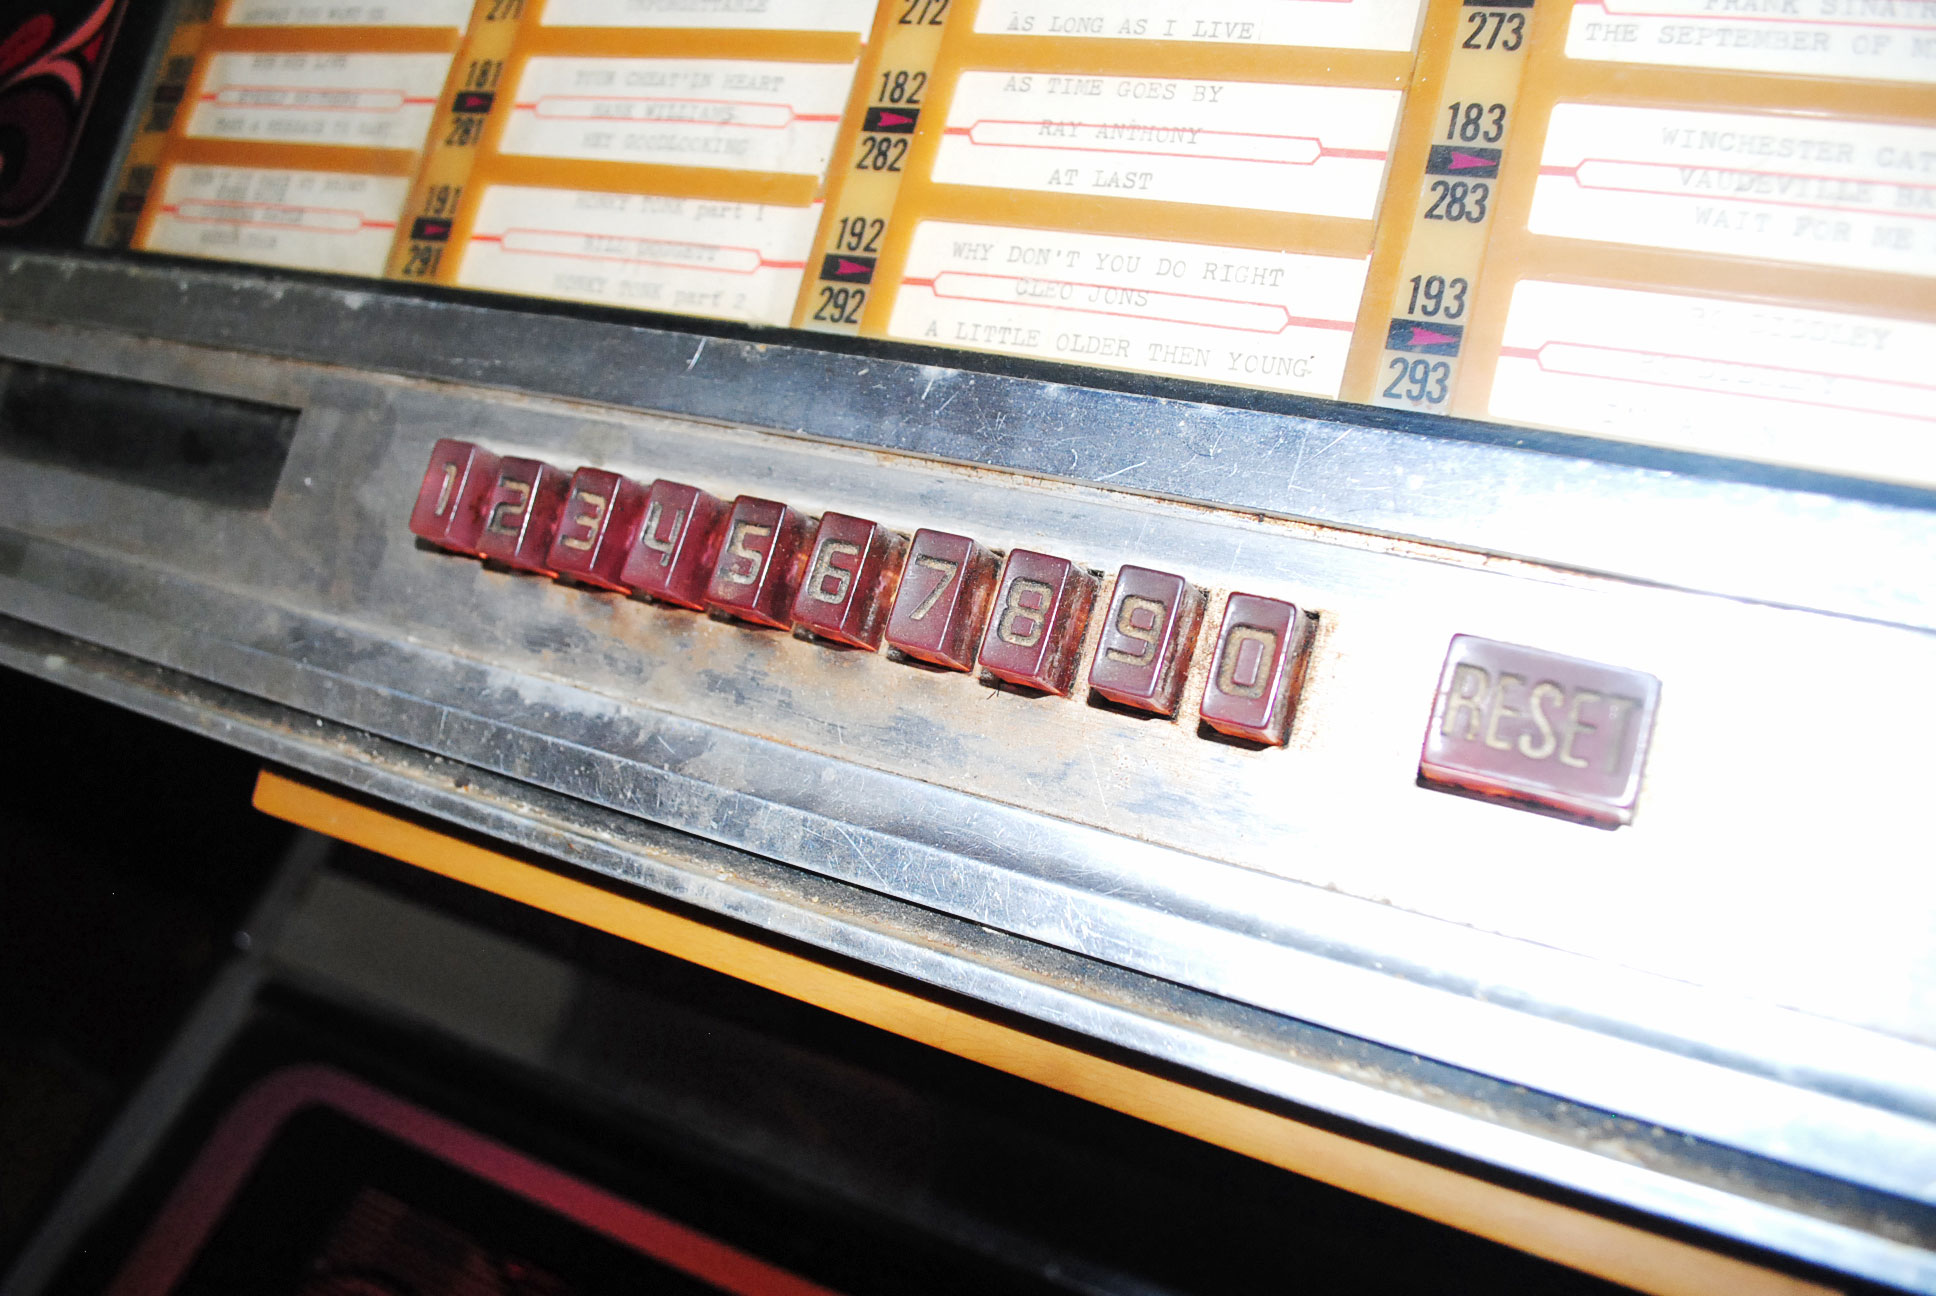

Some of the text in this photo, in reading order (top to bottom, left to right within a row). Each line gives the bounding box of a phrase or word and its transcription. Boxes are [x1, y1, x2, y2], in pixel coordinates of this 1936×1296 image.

[898, 0, 949, 25] 272
[1703, 0, 1800, 14] FRANK
[1006, 12, 1255, 40] AS LONG AS I LIVE
[1462, 12, 1526, 51] 273
[1586, 22, 1639, 43] THE
[1657, 24, 1830, 53] SEPTEMBER
[1852, 33, 1892, 56] OF
[463, 60, 504, 88] 181
[721, 73, 785, 92] HEART
[877, 70, 928, 105] 182
[1003, 75, 1226, 104] AS TIME GOES BY
[444, 117, 485, 147] 281
[1037, 119, 1204, 146] RAY ANTHONY
[1447, 102, 1507, 143] 183
[855, 137, 908, 172] 282
[1661, 126, 1855, 164] WINCHESTER
[1048, 168, 1154, 191] AT LAST
[1679, 167, 1873, 204] VAUDEVILLE
[423, 185, 464, 216] 191
[1424, 180, 1490, 224] 283
[834, 216, 885, 253] 192
[1695, 206, 1774, 233] WAIT
[1793, 214, 1853, 242] FOR
[402, 243, 445, 278] 291
[952, 241, 1285, 289] WHY DON'T YOU DO RIGHT
[732, 293, 747, 310] 2
[814, 286, 866, 324] 292
[1015, 278, 1149, 308] CLEO JONS
[1407, 275, 1469, 320] 193
[925, 319, 1309, 379] A LITTLE OLDER THEN YOUNG
[1382, 357, 1452, 404] 293
[435, 463, 1279, 699] 1 2 3 4 5 6 7 8 9 0
[1440, 661, 1645, 776] RESET
